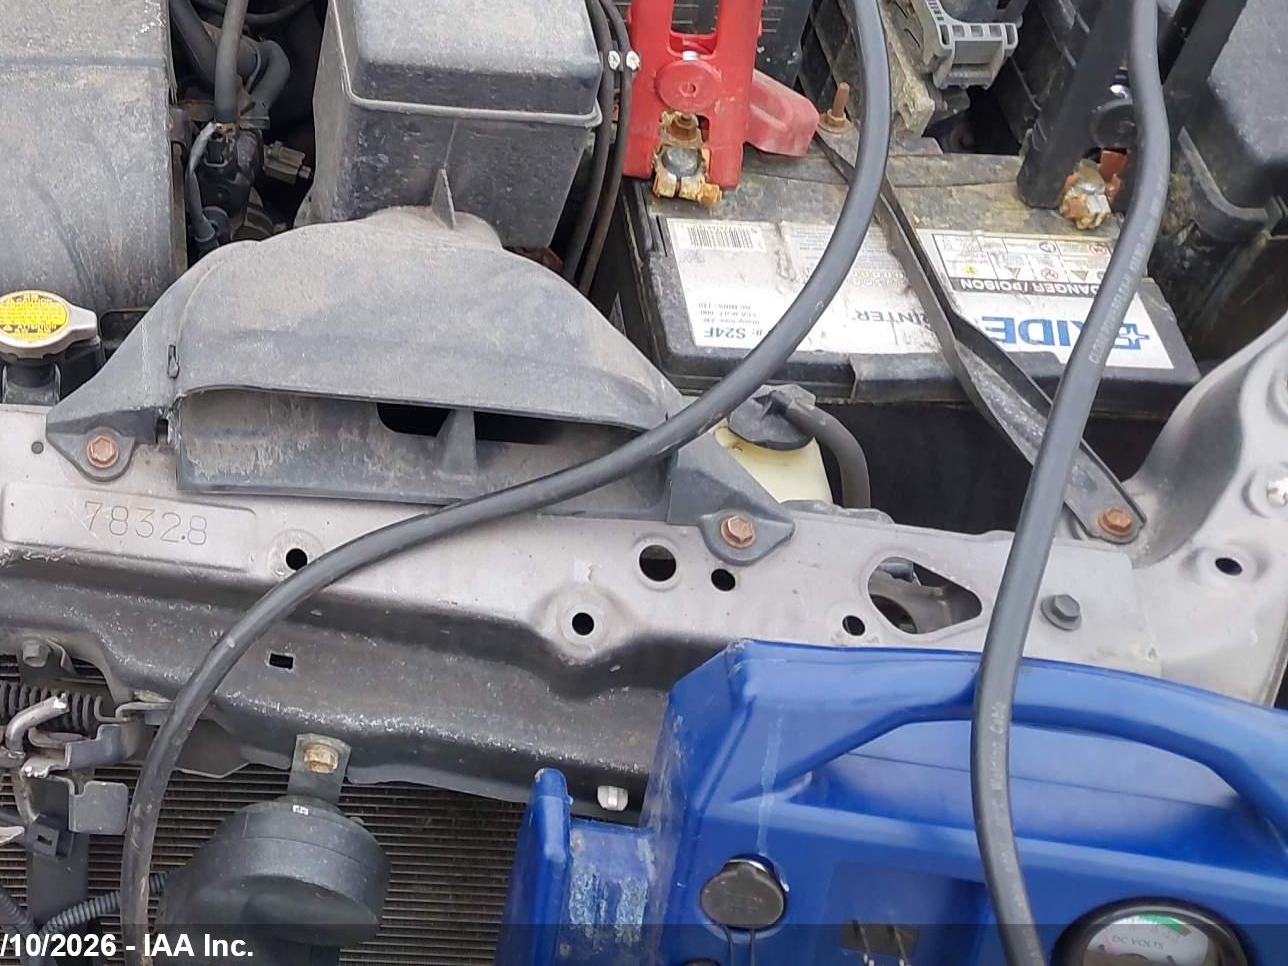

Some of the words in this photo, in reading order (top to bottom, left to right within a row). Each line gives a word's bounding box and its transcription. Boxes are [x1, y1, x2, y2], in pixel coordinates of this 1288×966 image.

[704, 326, 746, 340] S24F
[982, 316, 1149, 350] EIDE
[83, 500, 209, 547] 78328
